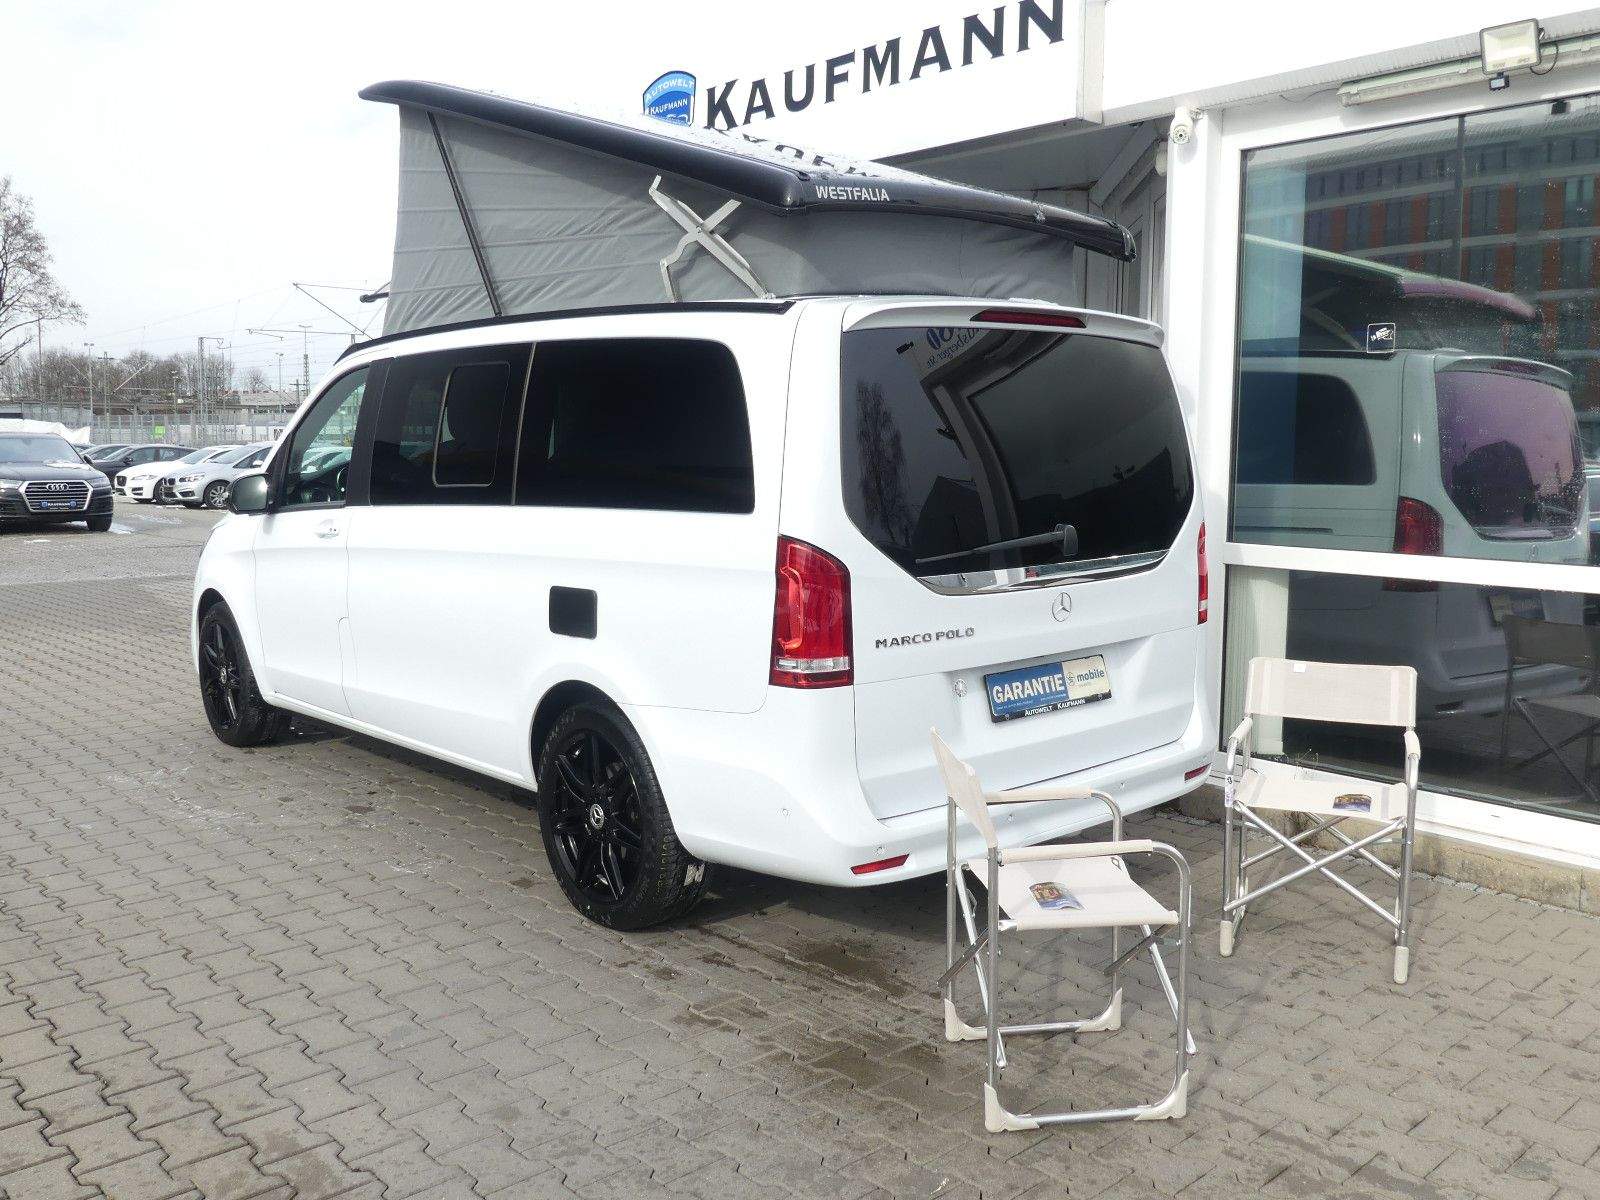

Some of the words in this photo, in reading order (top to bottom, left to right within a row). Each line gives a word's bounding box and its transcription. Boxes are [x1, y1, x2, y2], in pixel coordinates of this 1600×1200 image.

[703, 0, 1065, 130] KAUFMANN
[646, 78, 695, 100] AUTOWELT
[650, 98, 688, 115] KAUFMANN
[815, 185, 890, 202] WESTFALIA
[875, 633, 932, 649] MARCO
[935, 627, 975, 641] POLO
[992, 673, 1065, 704] GARANTIE
[1077, 669, 1105, 682] mobile
[1024, 705, 1053, 717] AUTOWELT
[1057, 698, 1086, 710] KAUFMANN
